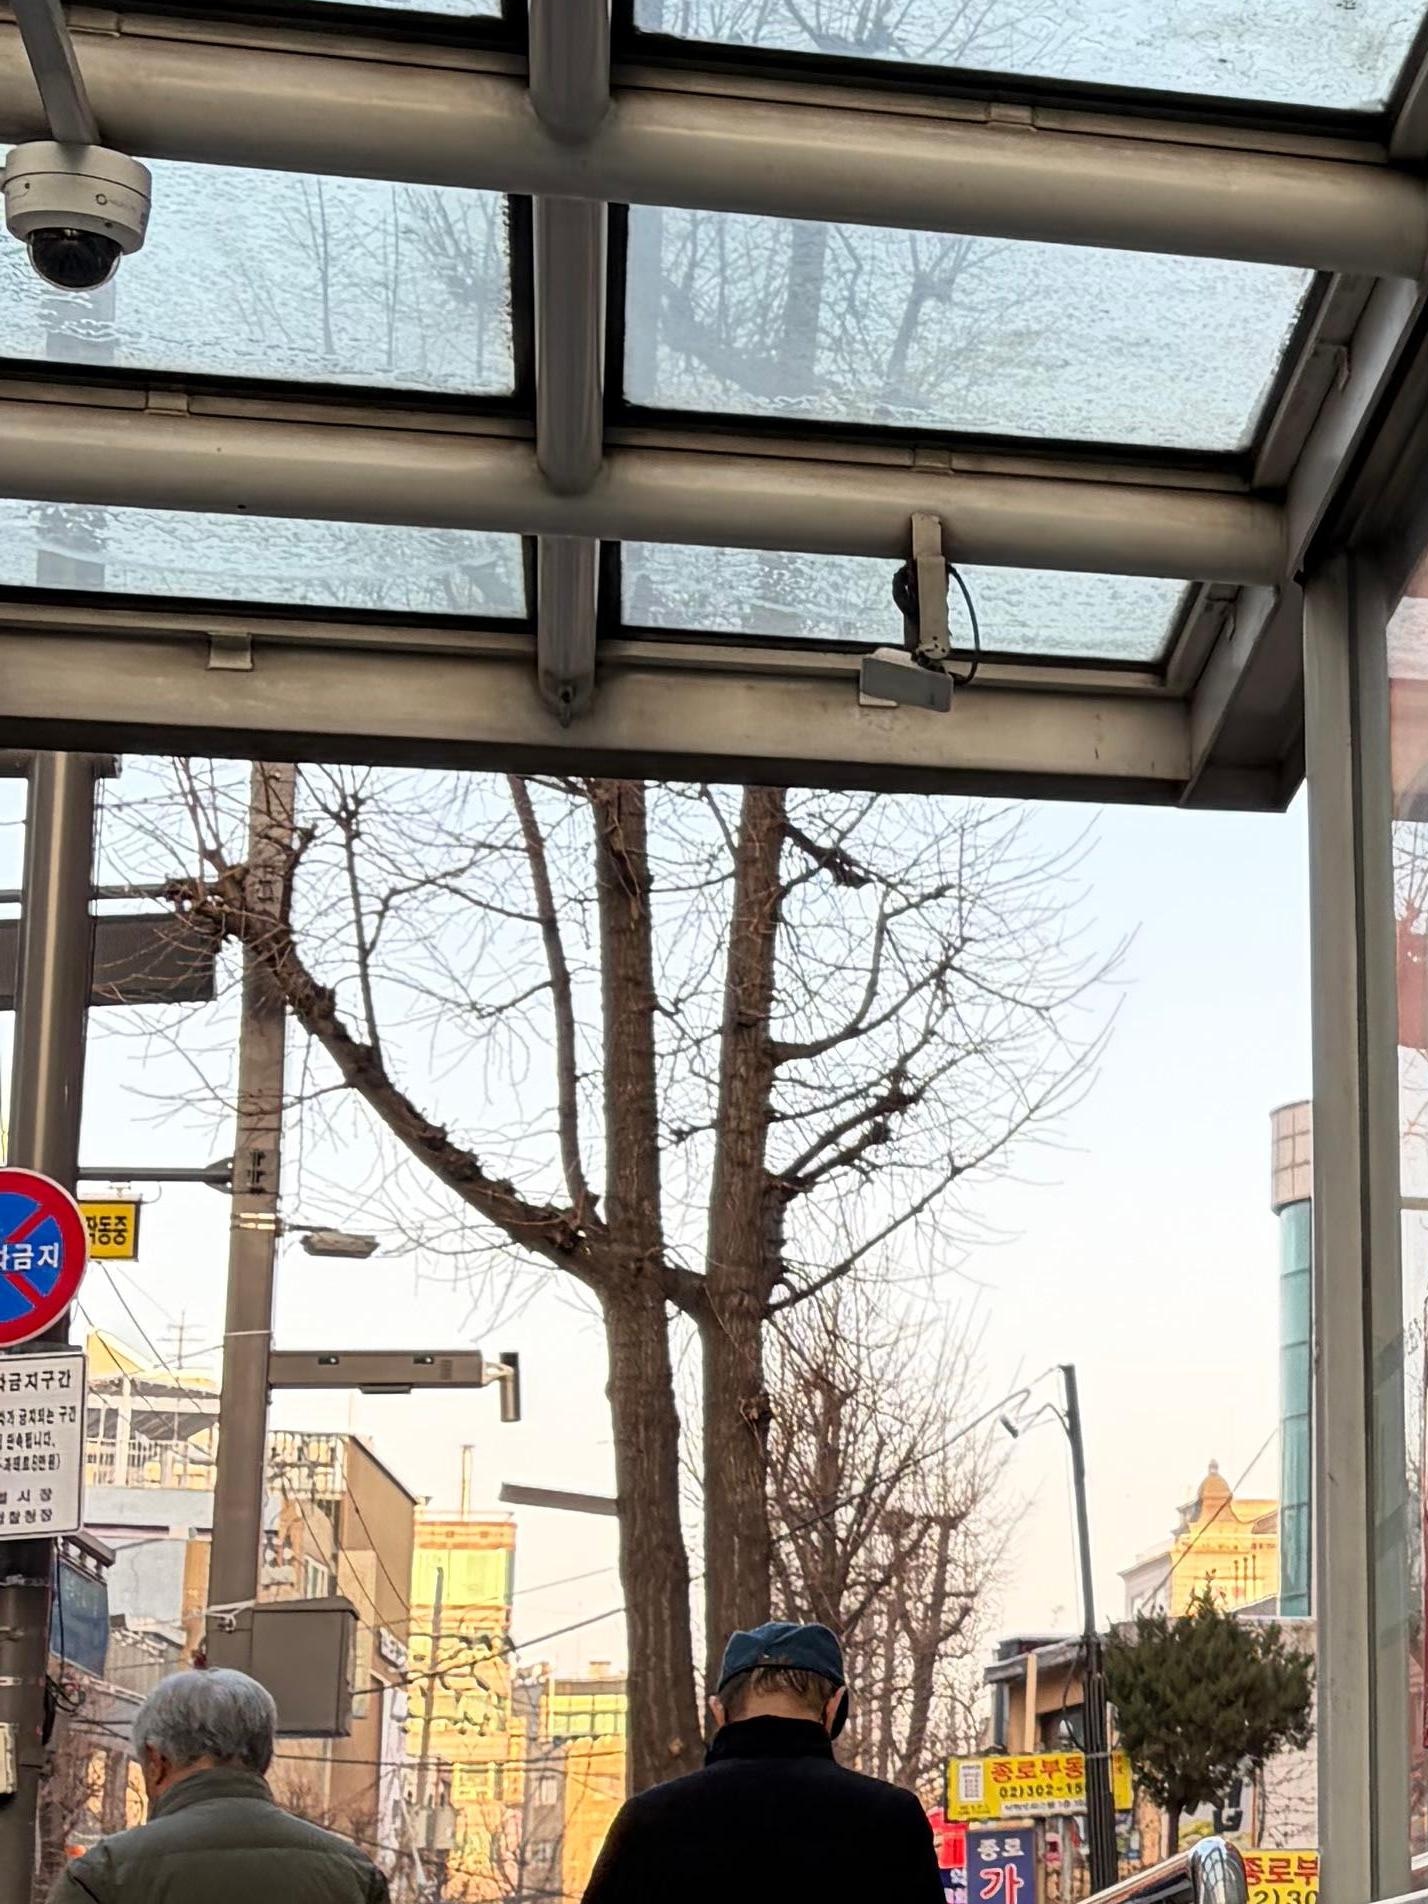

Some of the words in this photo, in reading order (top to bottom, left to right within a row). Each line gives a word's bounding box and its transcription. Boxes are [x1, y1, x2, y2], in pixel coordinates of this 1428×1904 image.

[991, 1755, 1084, 1784] 종로부동
[999, 1783, 1084, 1799] 02)302-15
[977, 1838, 1025, 1861] 종로
